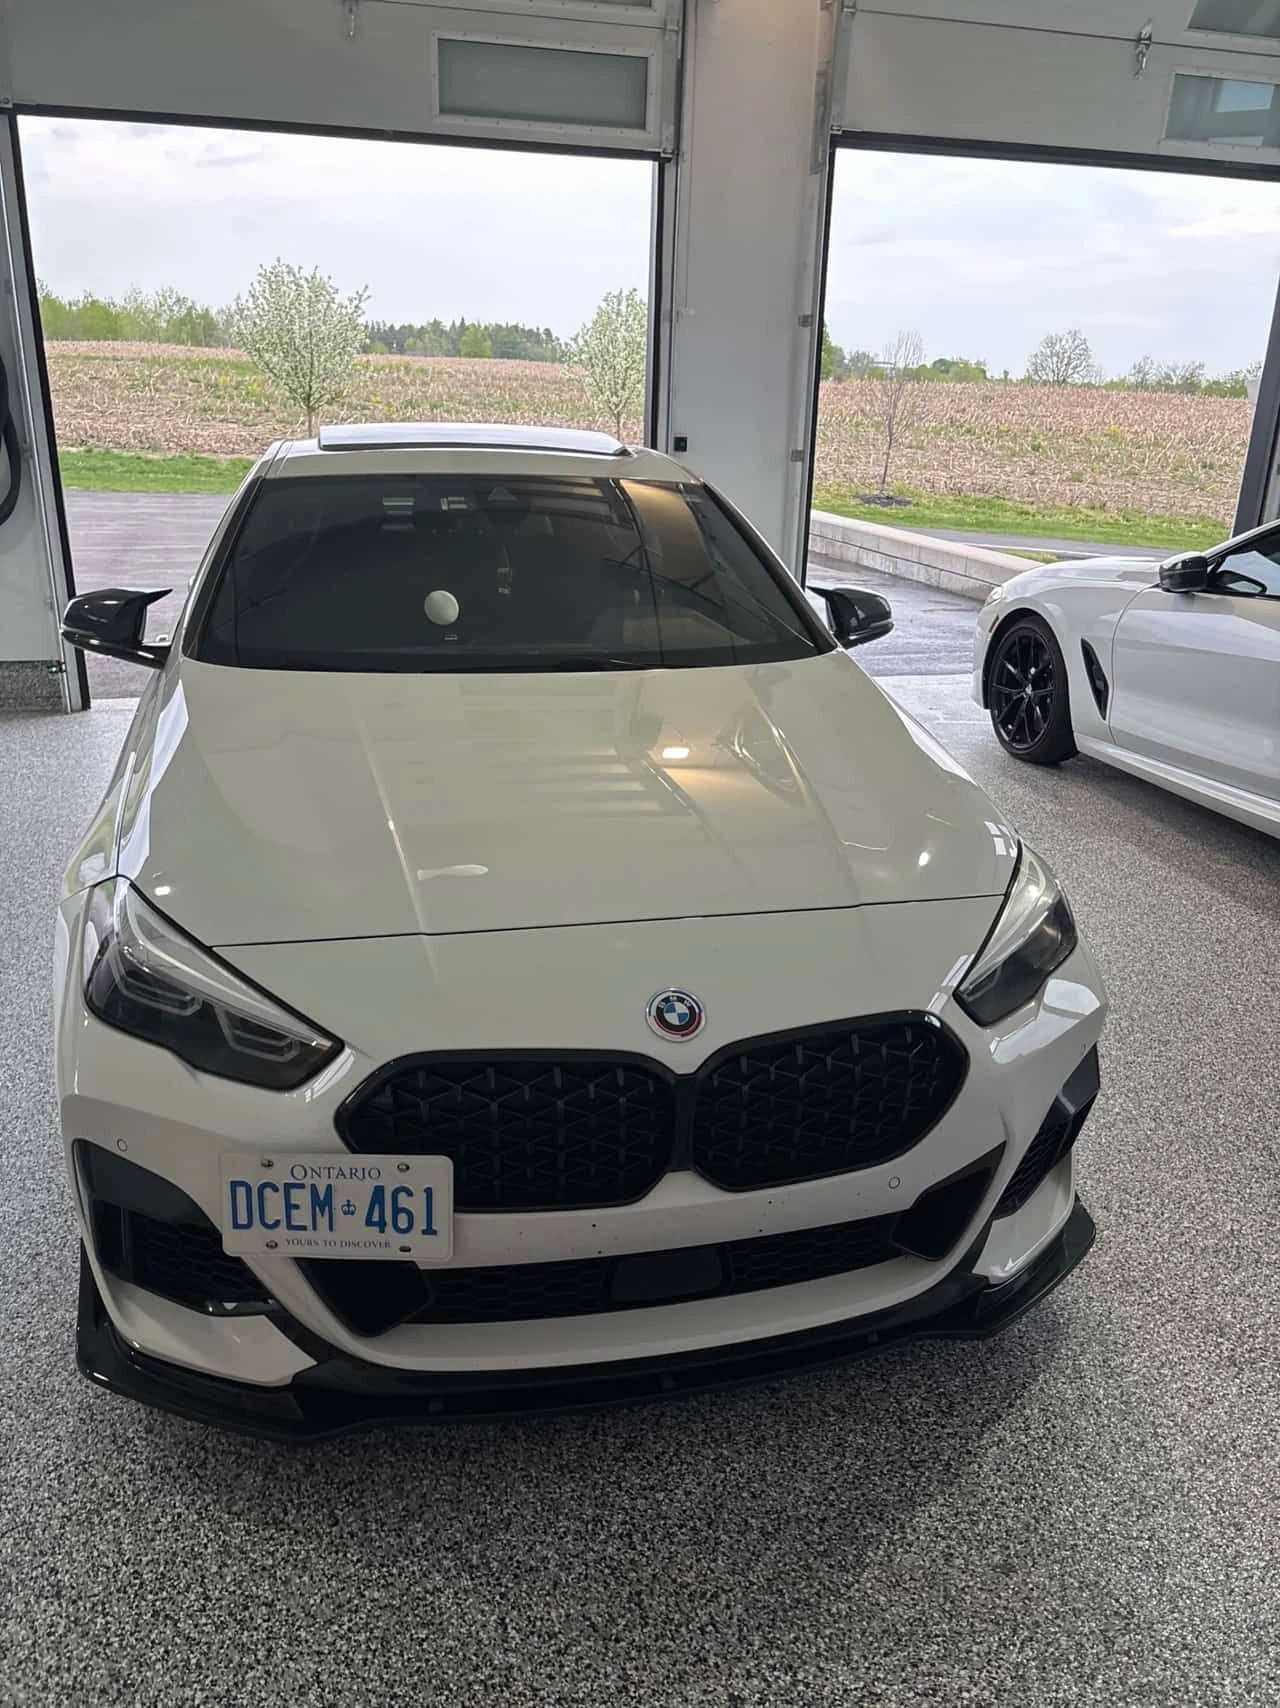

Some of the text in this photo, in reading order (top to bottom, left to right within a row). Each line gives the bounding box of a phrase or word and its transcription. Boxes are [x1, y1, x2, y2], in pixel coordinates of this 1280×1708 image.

[229, 1180, 438, 1236] DCEM 461
[286, 1239, 391, 1248] YOURS TO DISCOVER
